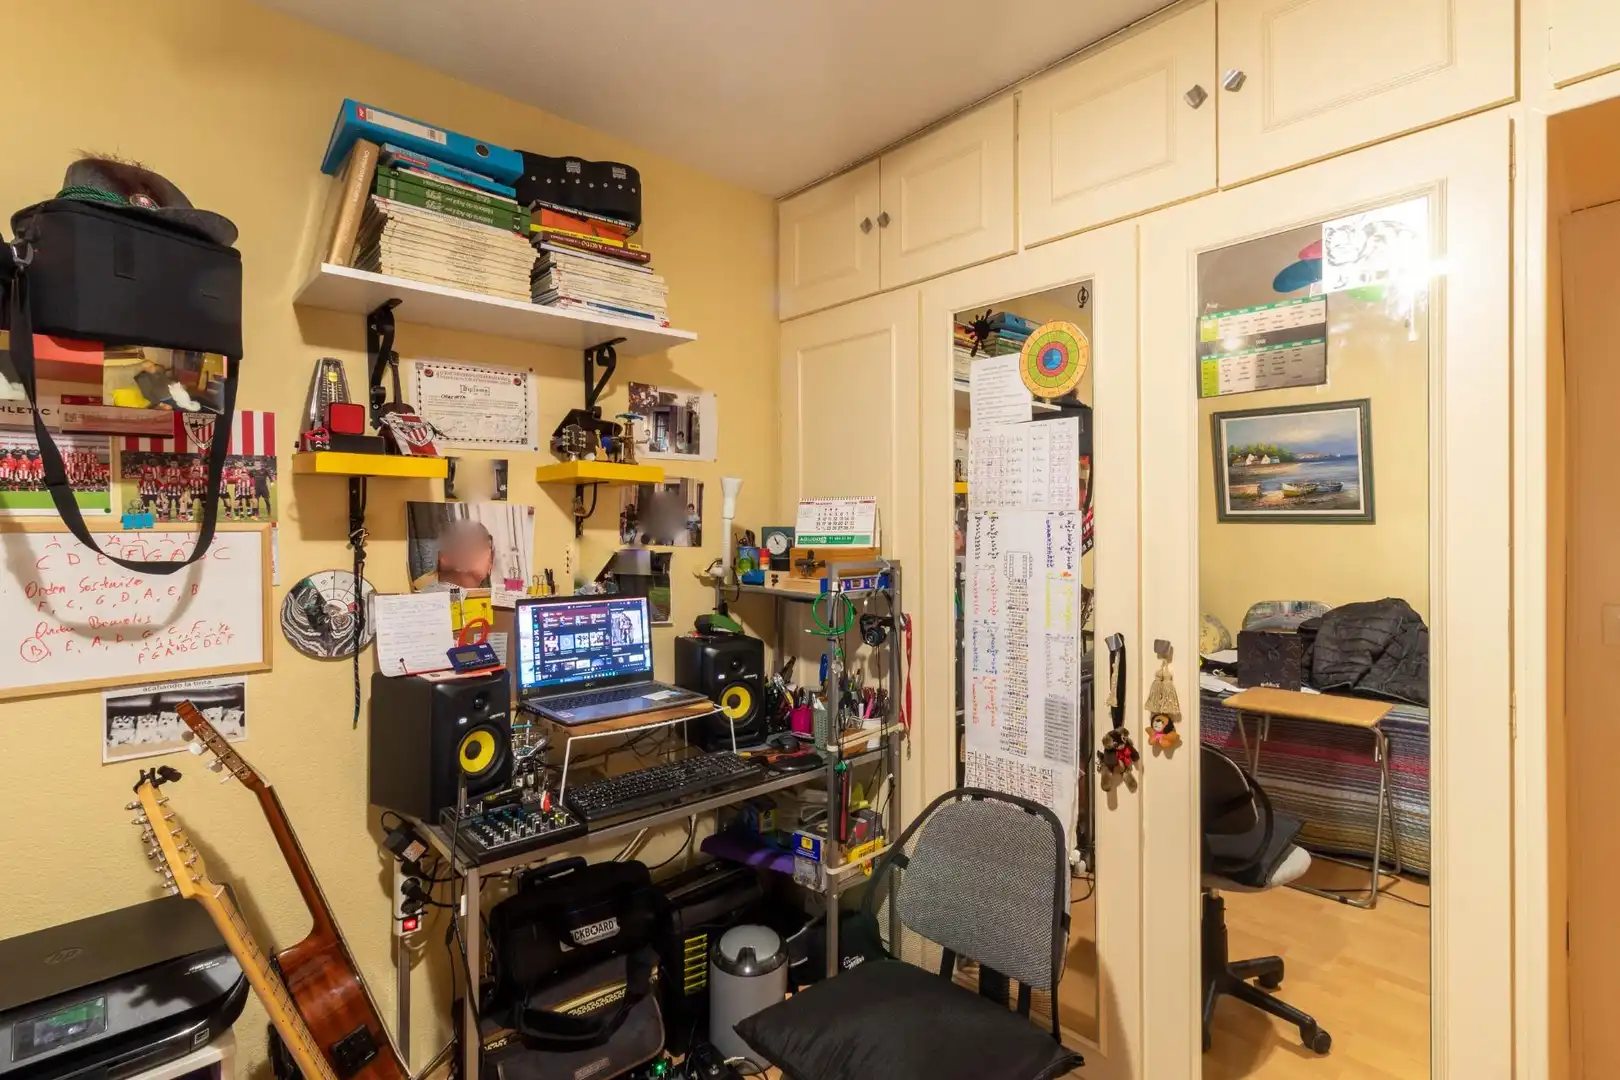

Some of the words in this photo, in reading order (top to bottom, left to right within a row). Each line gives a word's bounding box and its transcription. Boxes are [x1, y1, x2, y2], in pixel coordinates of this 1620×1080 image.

[0, 405, 50, 415] HLETC
[36, 555, 50, 570] C
[67, 553, 80, 566] D
[213, 546, 231, 560] C
[573, 919, 614, 941] CKBOARD
